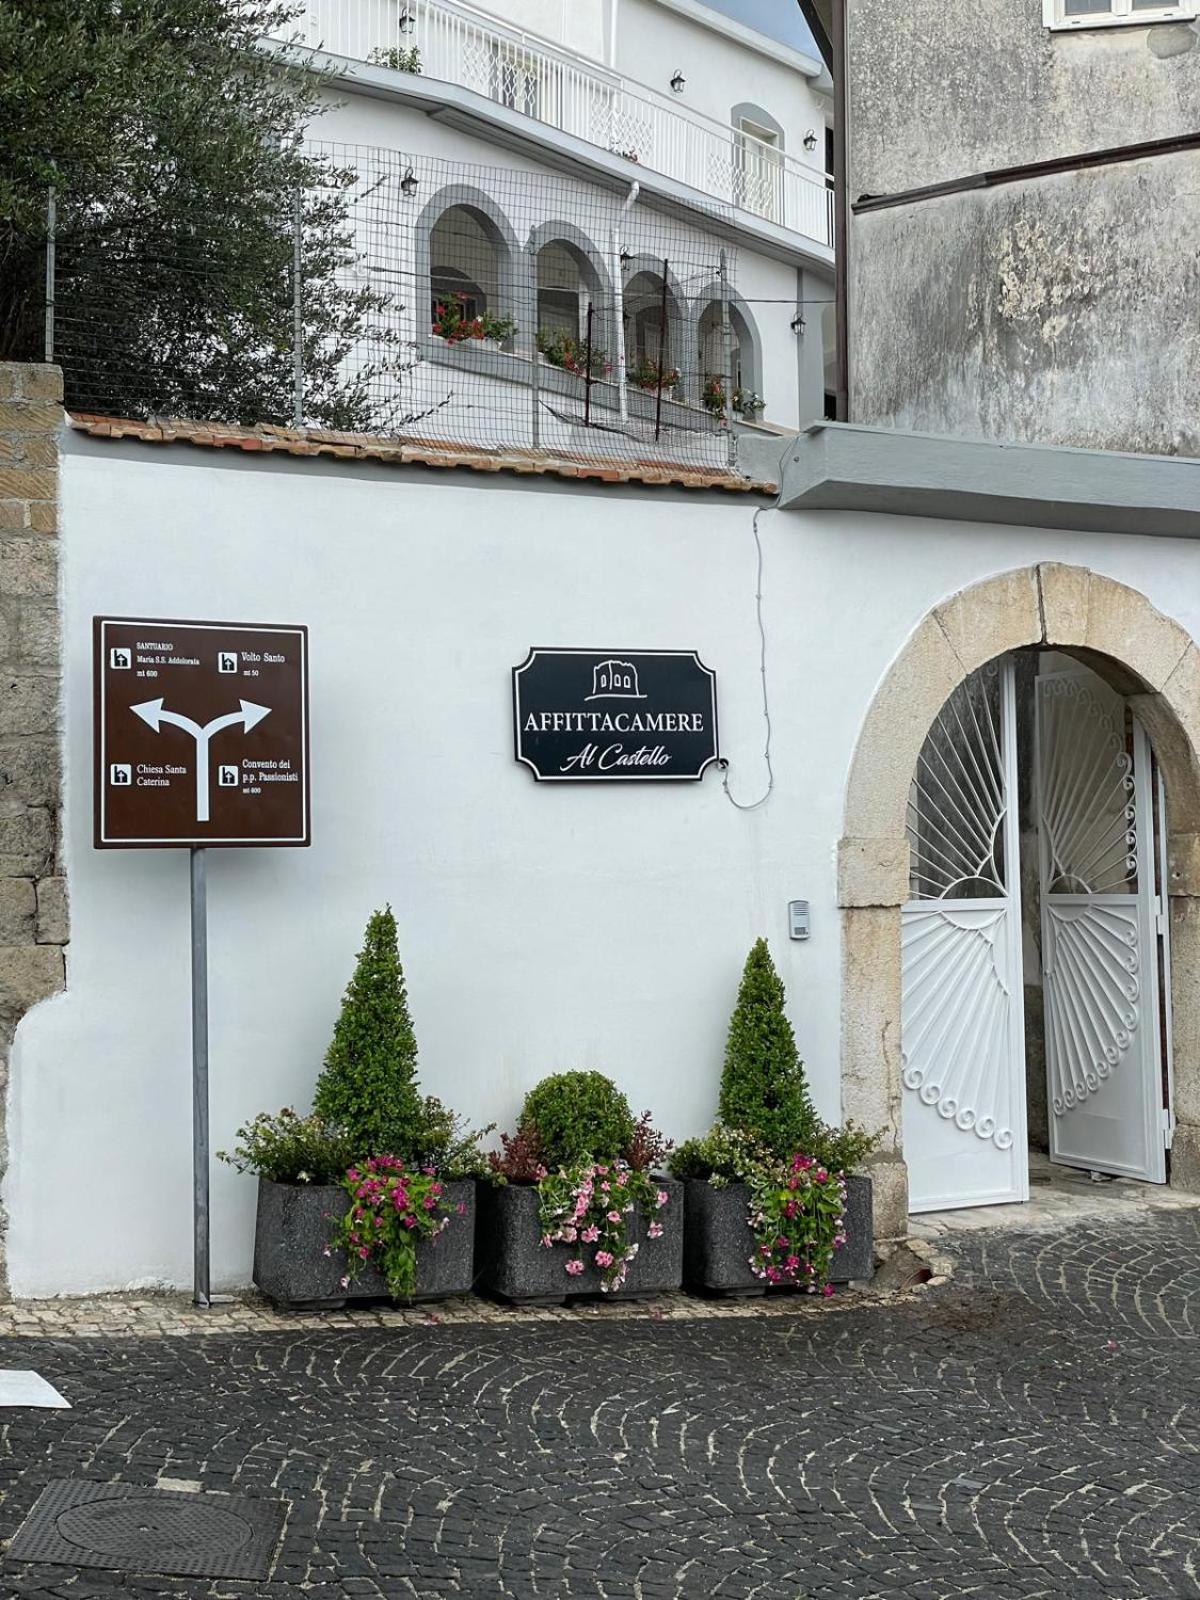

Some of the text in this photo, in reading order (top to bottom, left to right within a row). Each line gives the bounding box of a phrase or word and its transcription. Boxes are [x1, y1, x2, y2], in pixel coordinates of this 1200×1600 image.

[136, 642, 174, 652] SANTUARIO
[136, 655, 201, 666] Maria S.S. Addolorata
[241, 652, 286, 663] Volto Santo
[523, 712, 704, 733] AFFITTACAMERE
[559, 743, 673, 772] Al Castello
[136, 764, 187, 774] Chiesa Santa
[242, 759, 291, 769] Convento dei
[136, 776, 170, 786] Caterina
[242, 772, 299, 784] p.p. Passionisti
